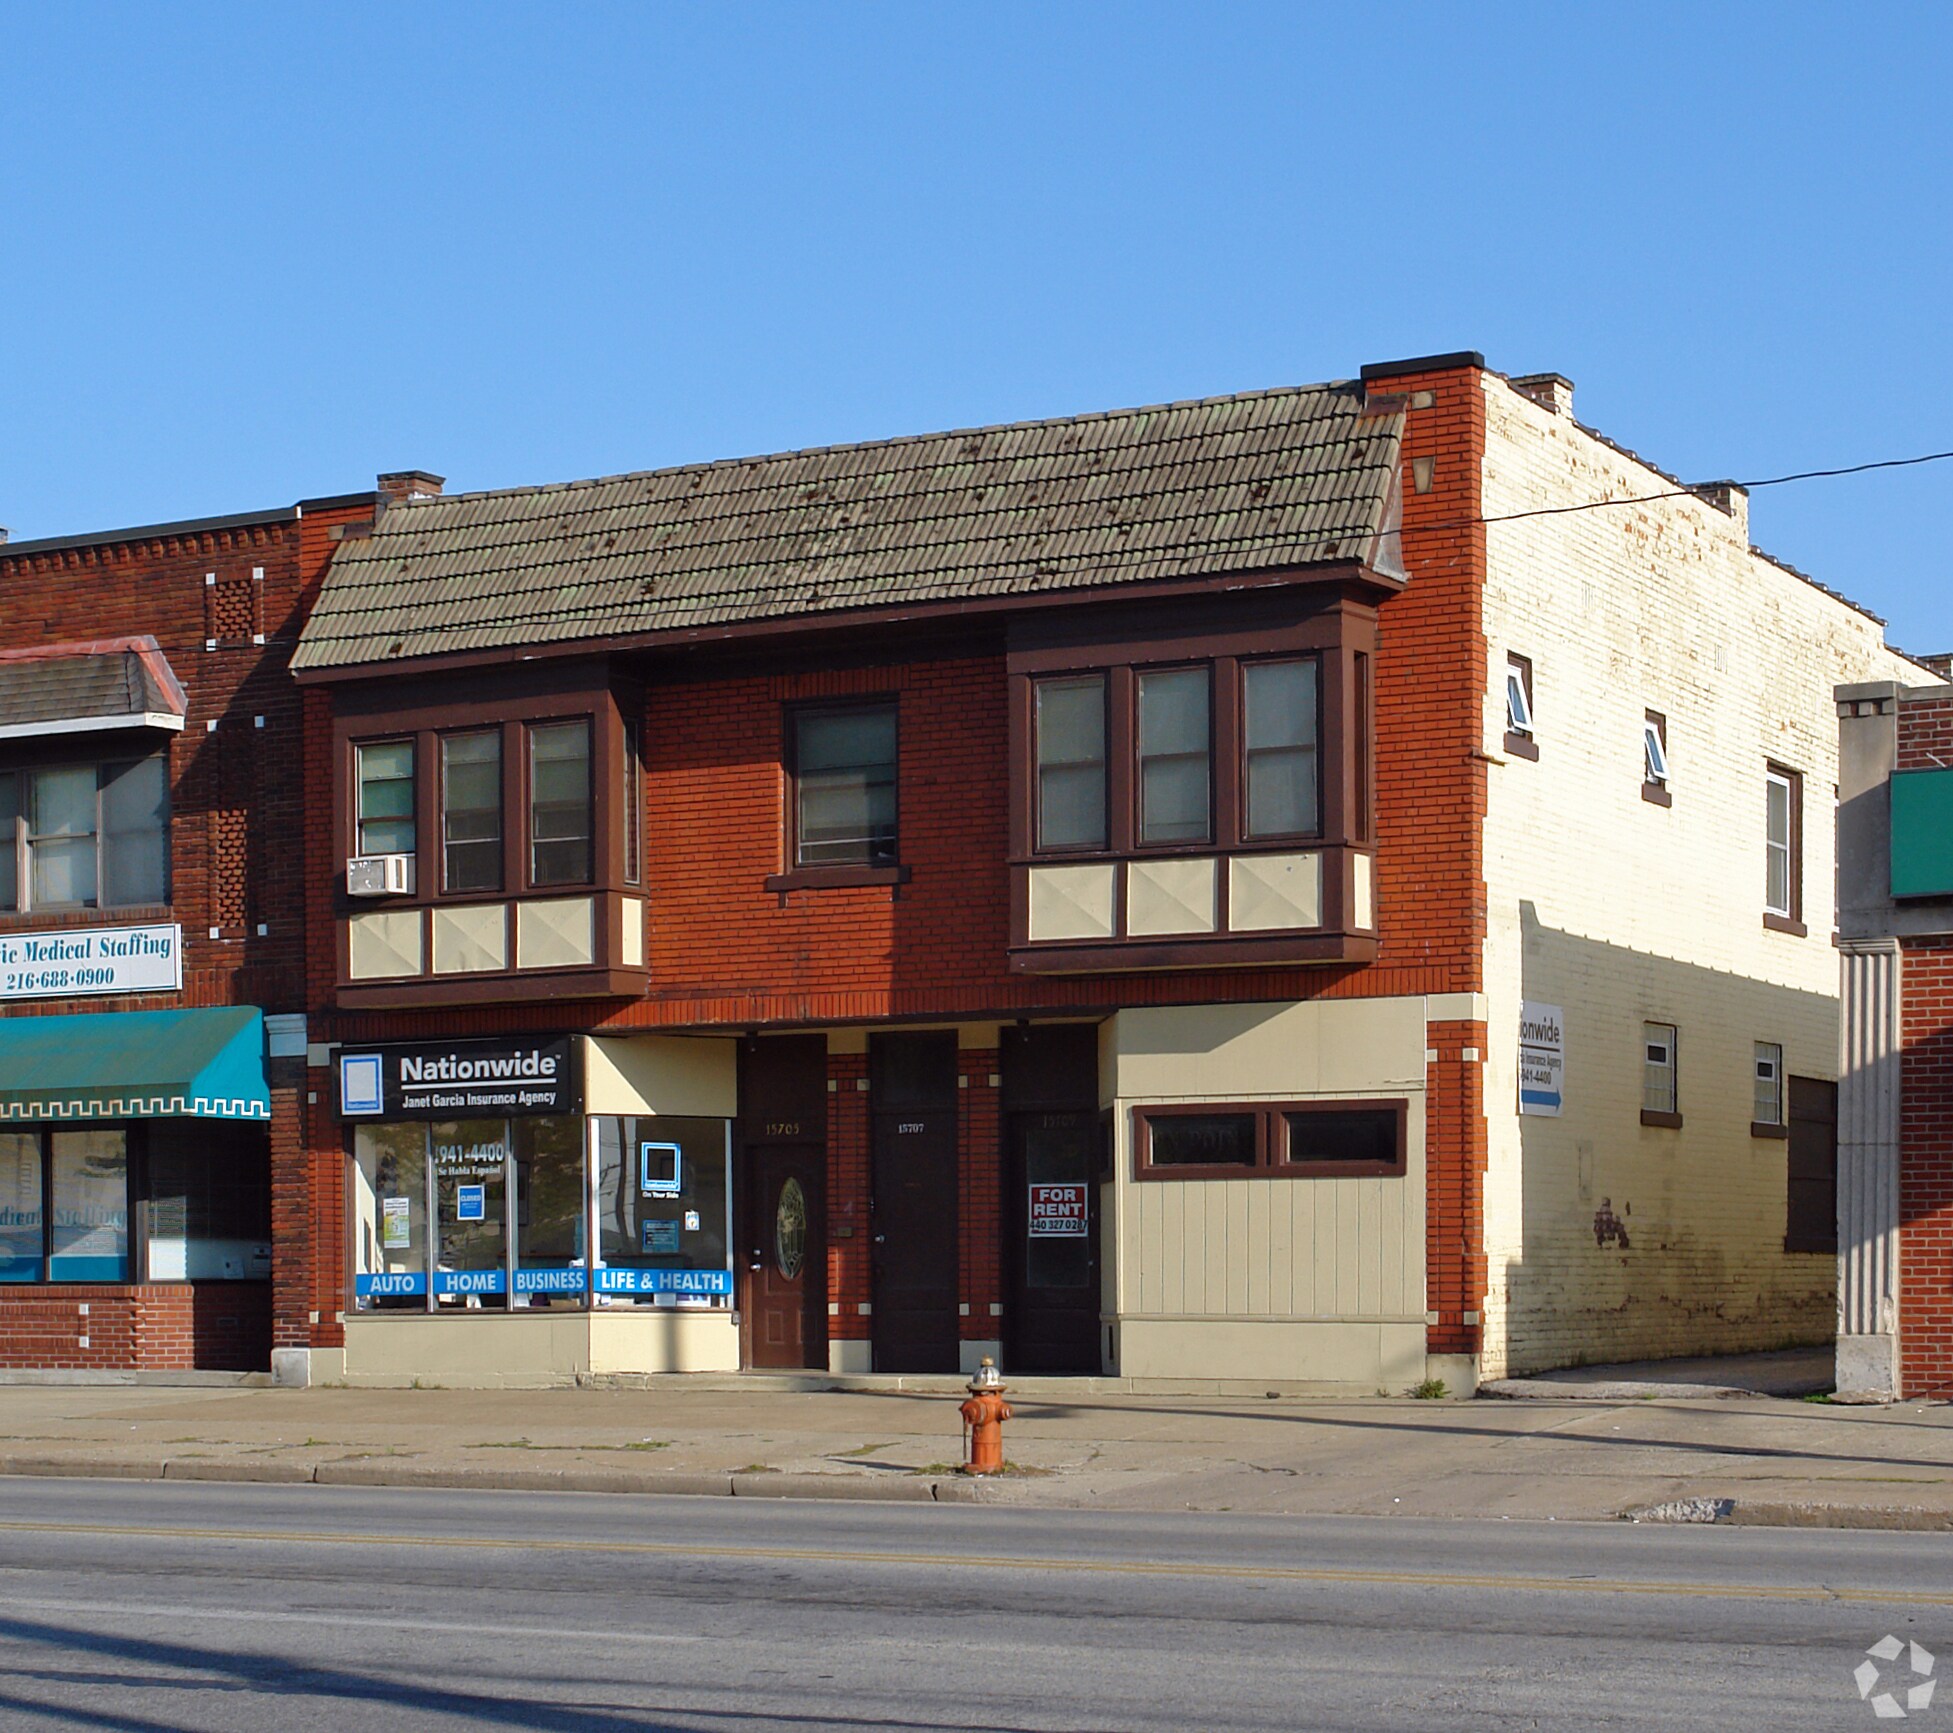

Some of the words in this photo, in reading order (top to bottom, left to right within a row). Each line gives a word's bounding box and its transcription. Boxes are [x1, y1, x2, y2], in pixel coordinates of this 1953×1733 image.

[0, 943, 17, 963] ic
[24, 937, 91, 962] Medical
[99, 932, 171, 959] Staffing
[1521, 1017, 1560, 1043] onwide
[401, 1050, 556, 1081] Nationwide
[402, 1095, 430, 1108] Janet
[432, 1093, 465, 1107] Garcia
[467, 1093, 516, 1106] Insurance
[518, 1090, 556, 1106] Agency
[898, 1123, 924, 1134] 15707
[438, 1167, 447, 1175] Se
[449, 1166, 470, 1175] Habla
[1039, 1188, 1076, 1202] FOR
[1033, 1203, 1082, 1216] RENT
[1030, 1220, 1047, 1230] 440
[1048, 1220, 1064, 1230] 327
[370, 1275, 415, 1292] AUTO
[446, 1273, 496, 1290] HOME
[516, 1272, 584, 1289] BUSINESS
[602, 1272, 635, 1290] LIFE
[641, 1274, 653, 1290] &
[659, 1273, 724, 1291] HEALTH
